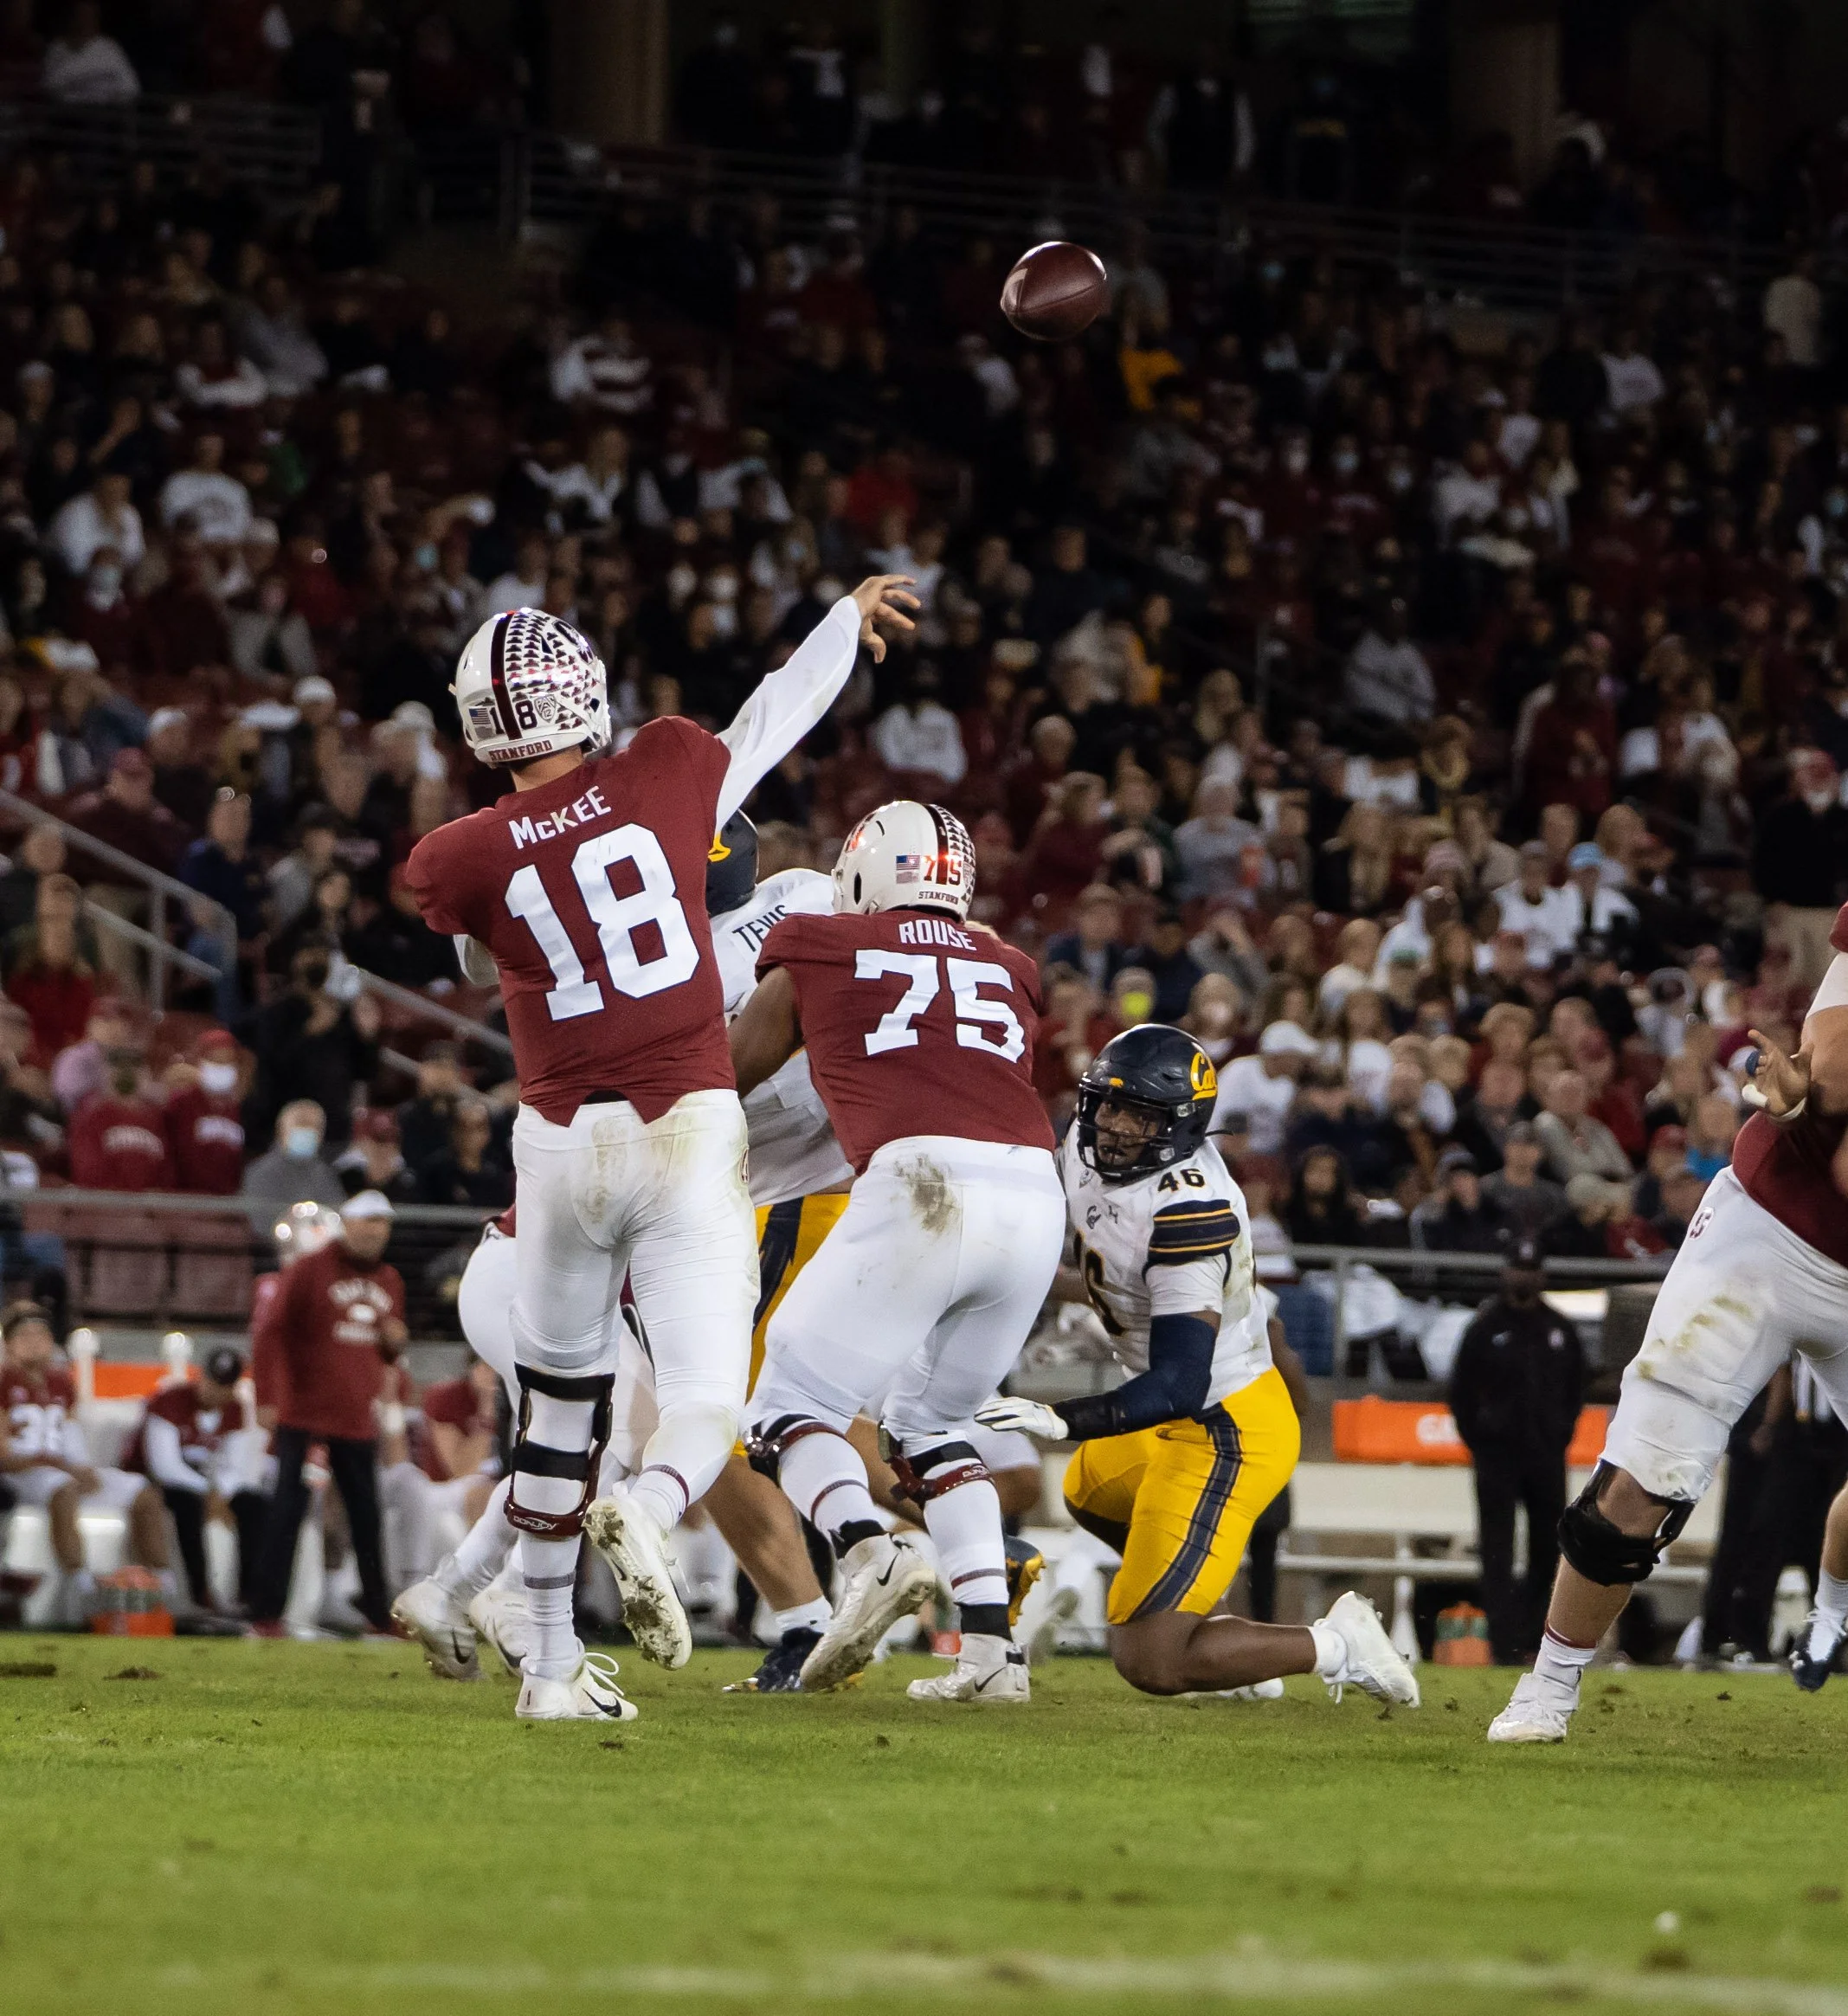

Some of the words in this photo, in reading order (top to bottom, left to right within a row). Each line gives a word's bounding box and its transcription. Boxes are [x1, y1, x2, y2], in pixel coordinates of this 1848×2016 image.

[489, 700, 538, 735] 18
[488, 739, 553, 762] STANFORD
[508, 785, 611, 849] McKEE
[922, 854, 963, 886] 75
[918, 891, 960, 905] STANFORD
[504, 822, 700, 1021] 18
[898, 919, 977, 950] ROUSE
[853, 949, 1026, 1063] 75
[1157, 1168, 1205, 1192] 46
